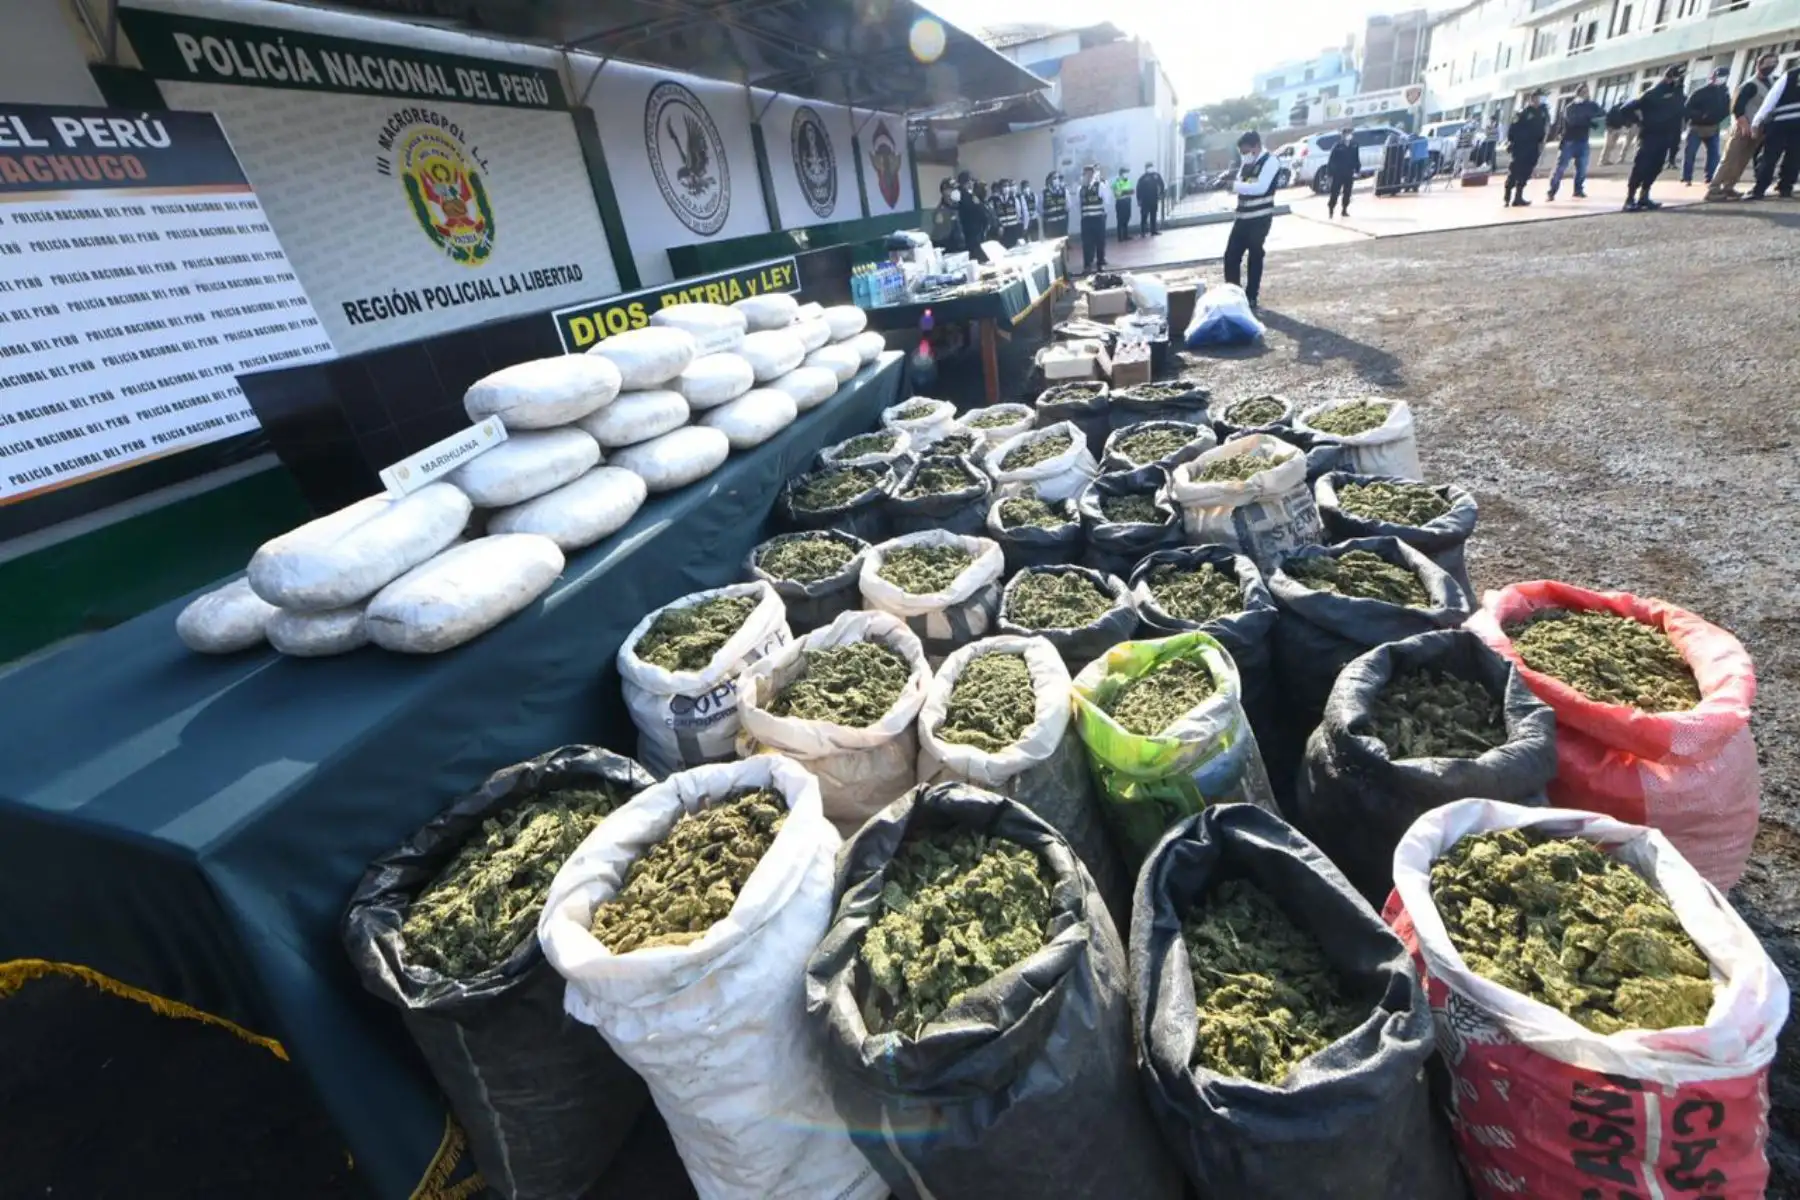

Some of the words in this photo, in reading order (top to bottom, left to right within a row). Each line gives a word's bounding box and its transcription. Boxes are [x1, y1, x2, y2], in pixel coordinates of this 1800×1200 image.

[172, 32, 323, 84] POLICÍA
[320, 50, 456, 97] NACIONAL
[455, 67, 500, 100] DEL
[498, 72, 549, 105] PERÚ
[0, 115, 49, 147] EL
[50, 112, 172, 148] PERÚ
[0, 154, 147, 184] ACHUCO
[342, 288, 423, 325] REGIÓN
[422, 279, 500, 310] POLICIAL
[500, 275, 522, 295] LA
[521, 263, 583, 290] LIBERTAD
[660, 278, 743, 308] PATRIA
[761, 265, 793, 292] LEY
[420, 440, 480, 474] MARIHUANA
[1664, 1099, 1727, 1200] CAS
